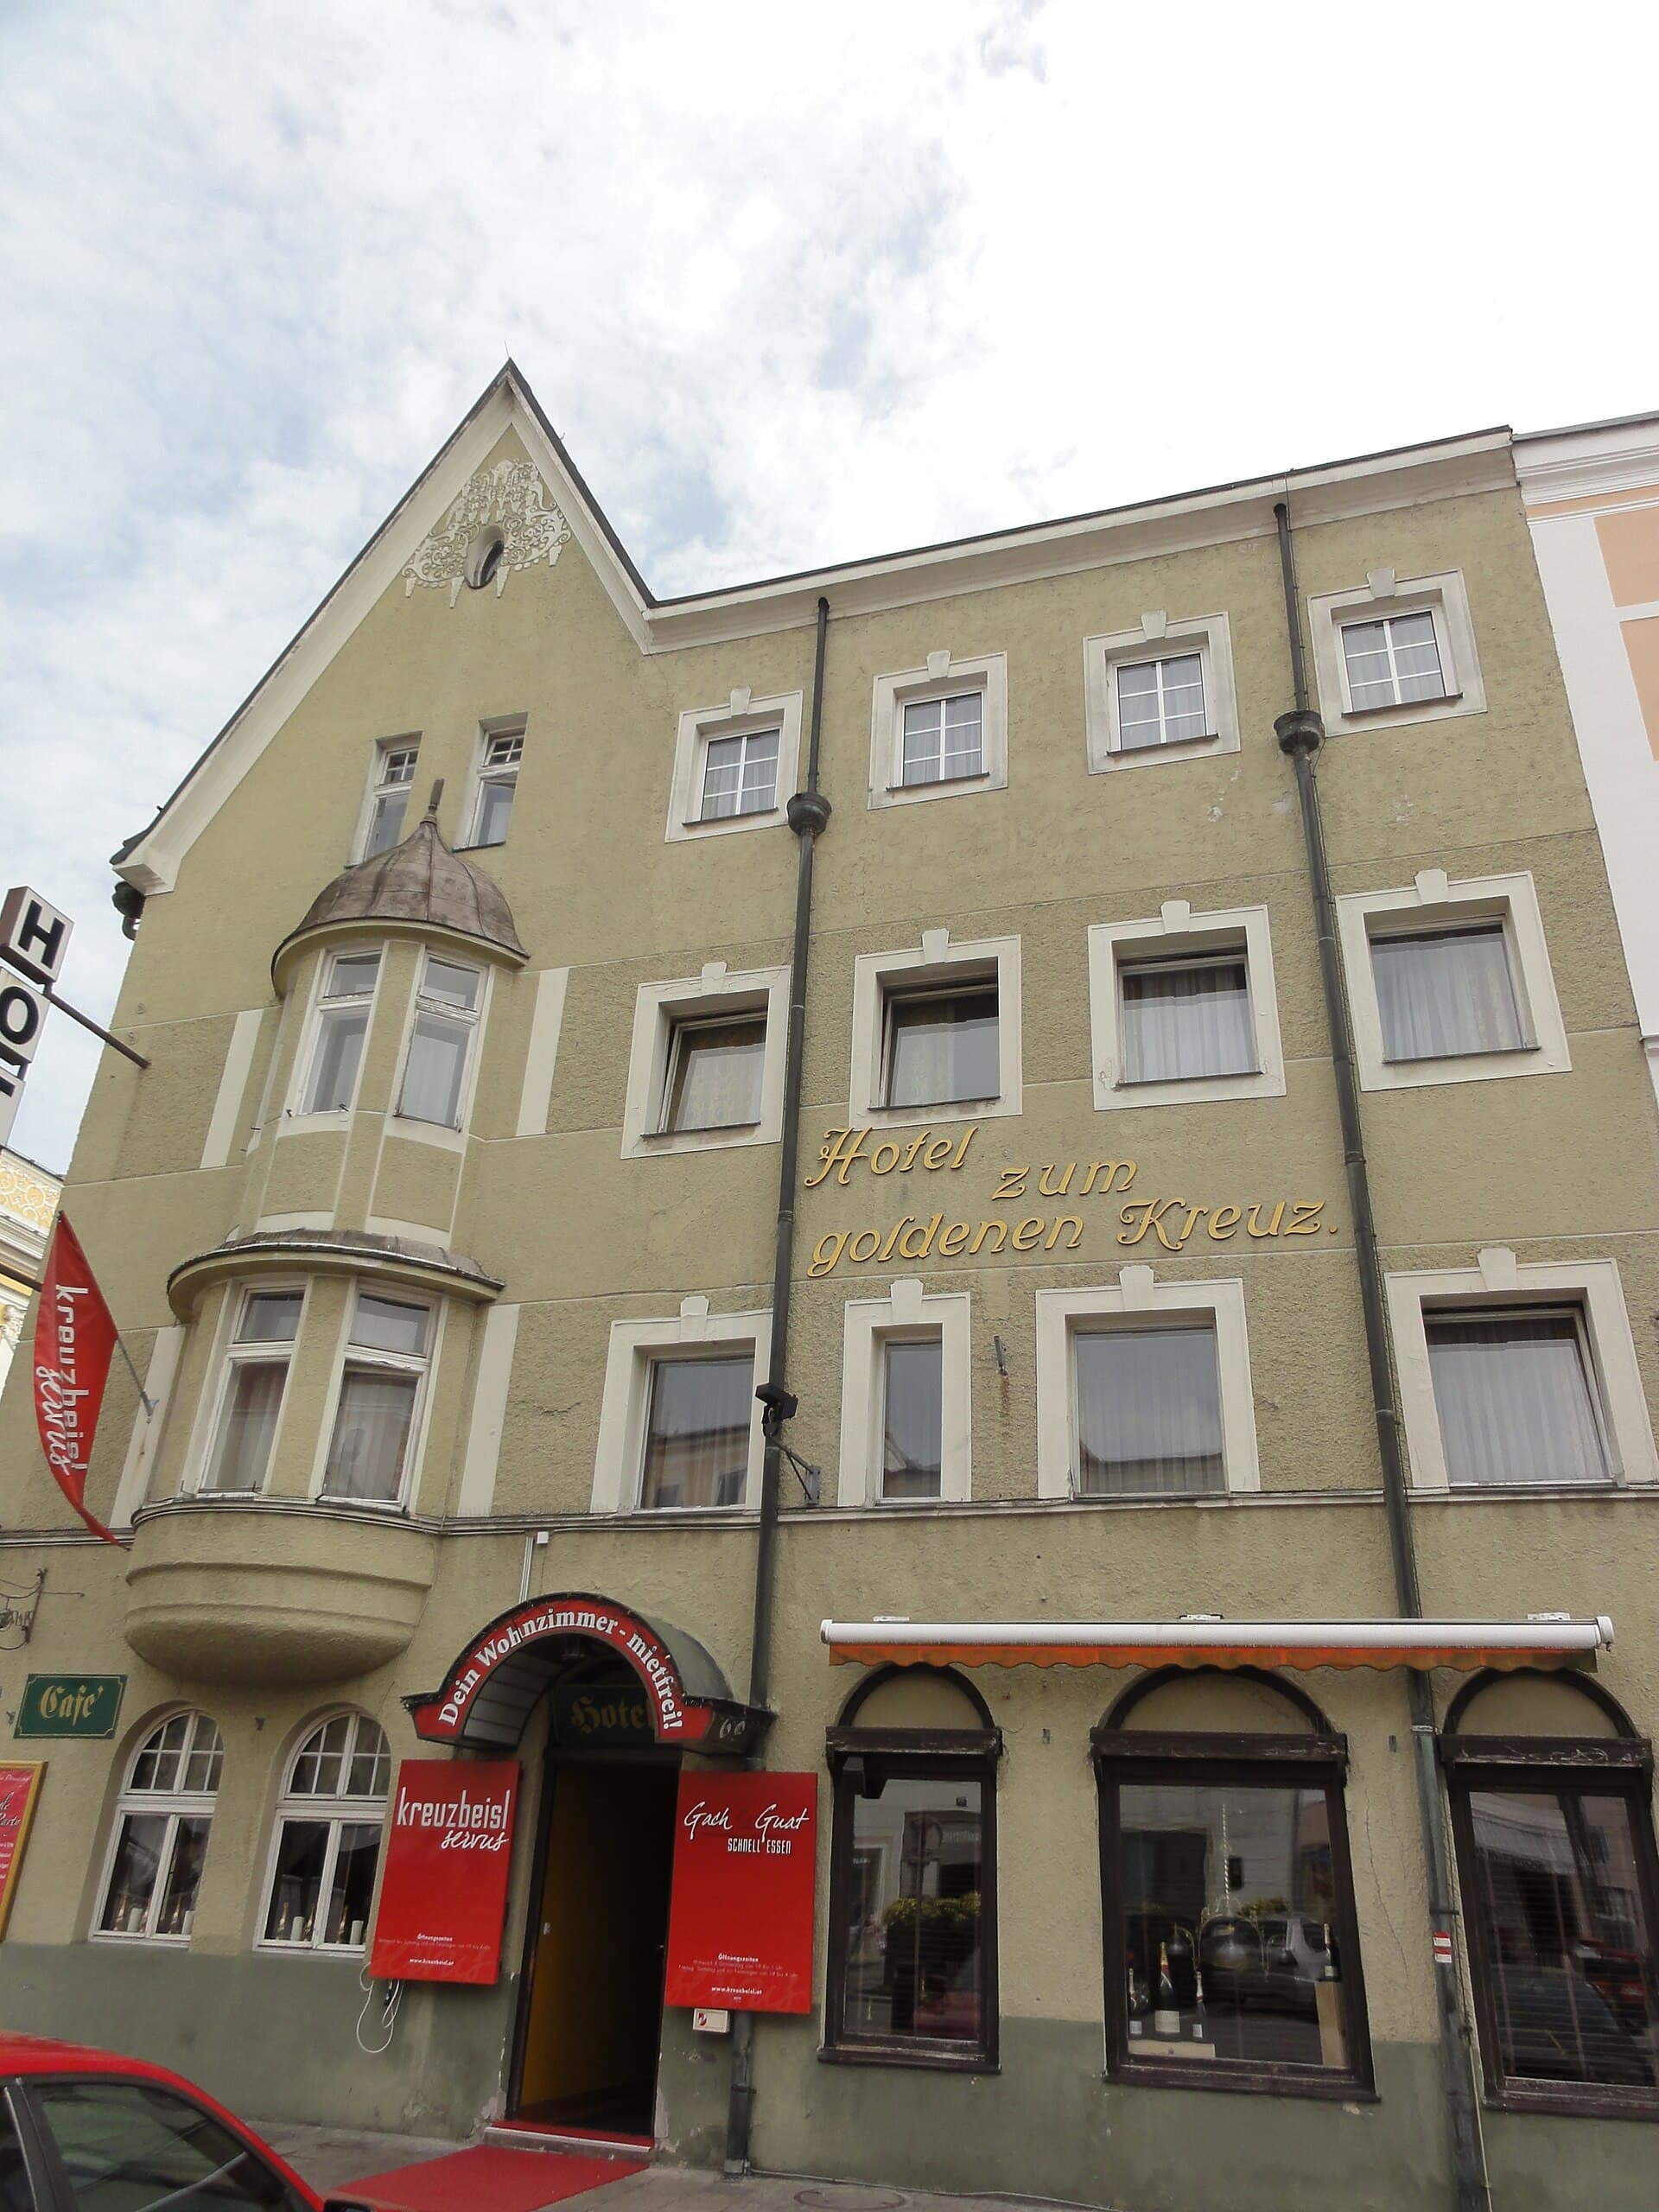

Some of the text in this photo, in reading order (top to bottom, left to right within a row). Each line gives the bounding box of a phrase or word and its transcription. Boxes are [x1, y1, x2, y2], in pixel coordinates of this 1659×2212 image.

[804, 1126, 980, 1189] Hotel
[991, 1159, 1138, 1201] zum
[806, 1197, 1339, 1279] goldenen Kreuz.
[55, 1283, 90, 1471] kreuzbeisl
[35, 1363, 71, 1477] servus
[437, 1668, 481, 1727] Dein
[474, 1607, 619, 1668] Wohnzimmer
[626, 1631, 684, 1731] mietfrei!
[570, 1694, 648, 1735] Hote
[396, 1786, 512, 1830] kreuzbeisl
[683, 1801, 810, 1843] Gach Guat
[441, 1829, 510, 1852] servus
[728, 1837, 791, 1855] SCHNELL ESSEN
